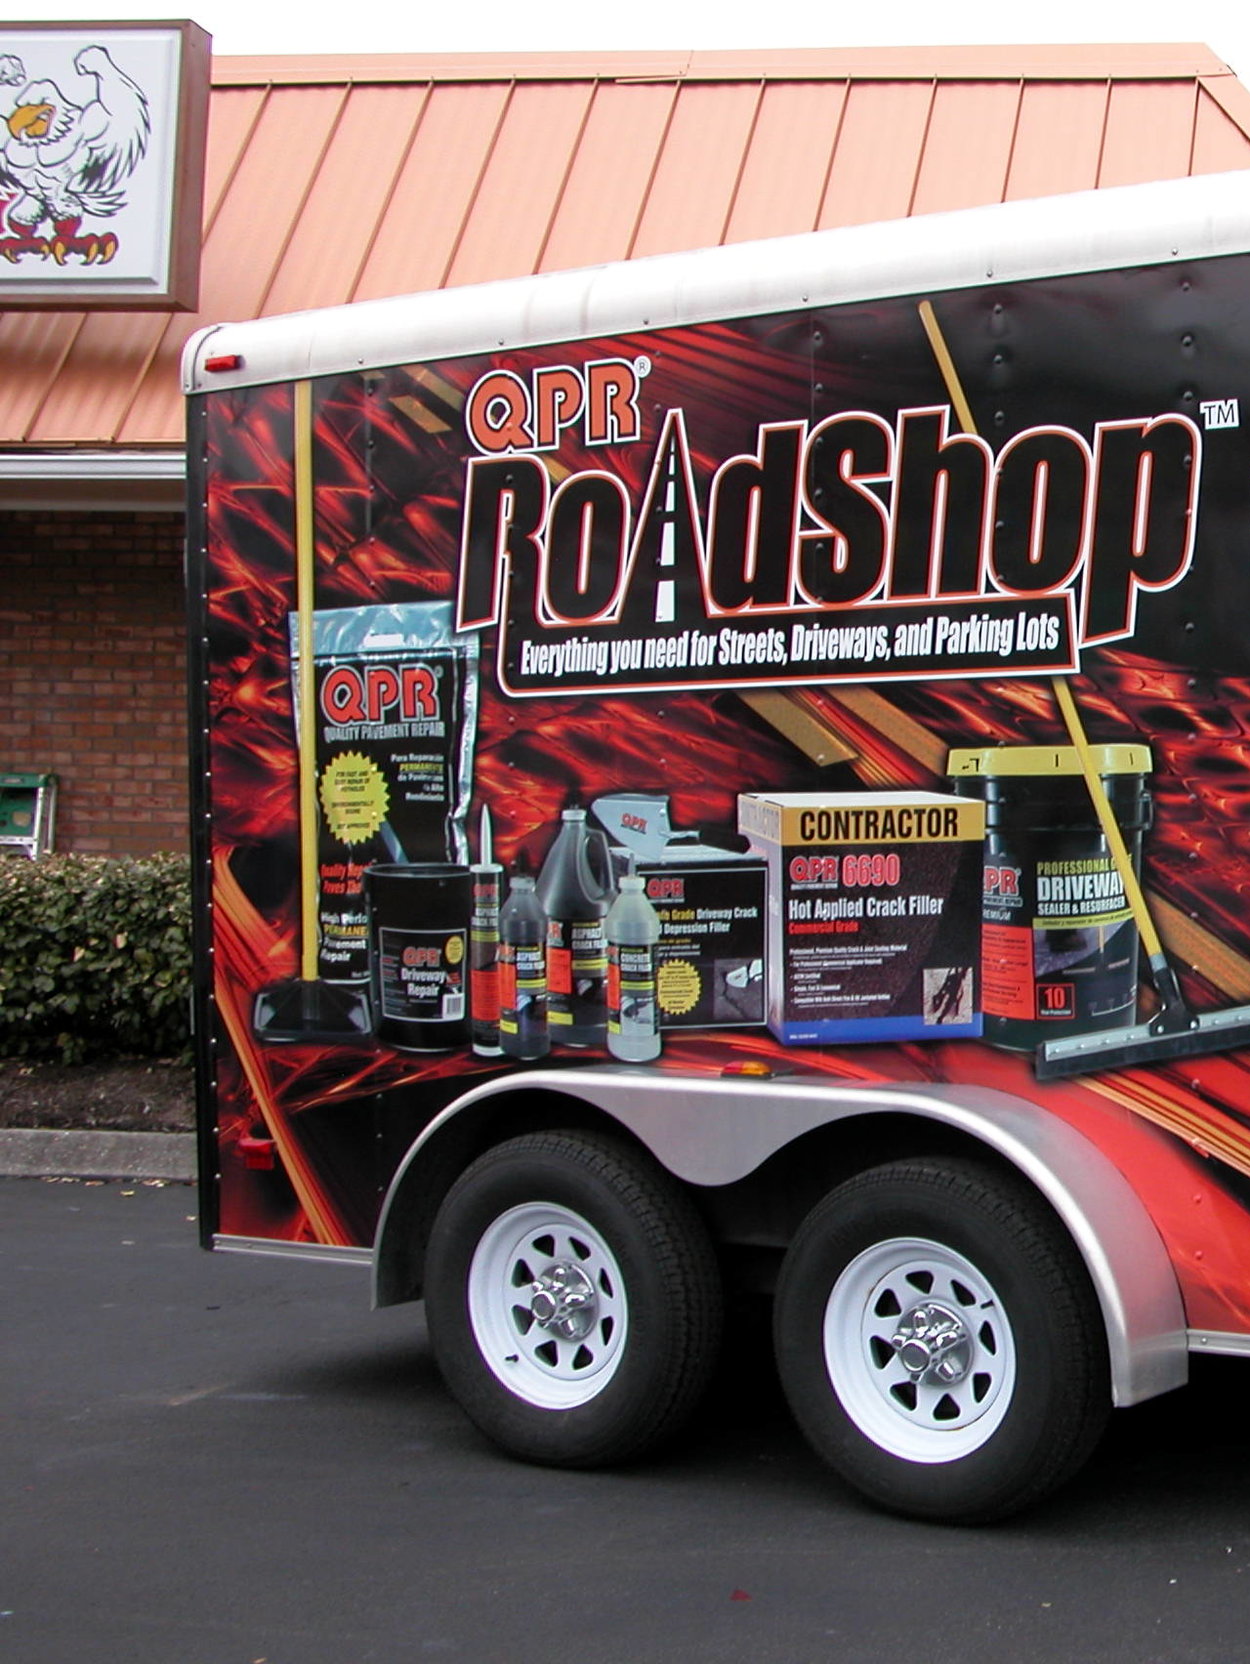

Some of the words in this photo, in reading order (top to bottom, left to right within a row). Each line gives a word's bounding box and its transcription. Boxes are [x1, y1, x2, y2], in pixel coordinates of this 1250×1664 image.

[467, 358, 641, 456] QPR
[521, 637, 609, 677] Everything
[610, 637, 643, 674] you
[644, 631, 690, 668] need
[691, 630, 717, 666] for
[719, 627, 788, 666] Streets,
[790, 623, 891, 662] Driveways,
[894, 617, 934, 656] and
[935, 613, 1014, 656] Parking
[1015, 612, 1059, 651] Lots
[320, 663, 440, 727] QPR
[324, 726, 360, 743] QUALITY
[361, 723, 410, 740] PAVEMENT
[411, 721, 445, 738] REPAIR
[800, 807, 958, 841] CONTRACTOR
[789, 855, 839, 882] QPR
[842, 853, 900, 887] 6690
[1037, 858, 1108, 876] PROFESSIONAL
[647, 878, 684, 898] QPR
[983, 865, 1019, 896] PR
[341, 911, 368, 925] Perfo
[696, 907, 733, 920] Driveway
[734, 906, 758, 919] Crack
[788, 899, 811, 920] Hot
[814, 897, 864, 922] Applied
[866, 896, 906, 917] Crack
[908, 895, 944, 916] Filler
[1037, 901, 1070, 916] SEALER
[1072, 903, 1079, 915] &
[664, 922, 708, 935] Depression
[709, 921, 731, 933] Filler
[403, 946, 440, 968] QPR
[401, 967, 446, 985] Driveway
[407, 983, 440, 998] Repair
[1044, 986, 1065, 1009] 10
